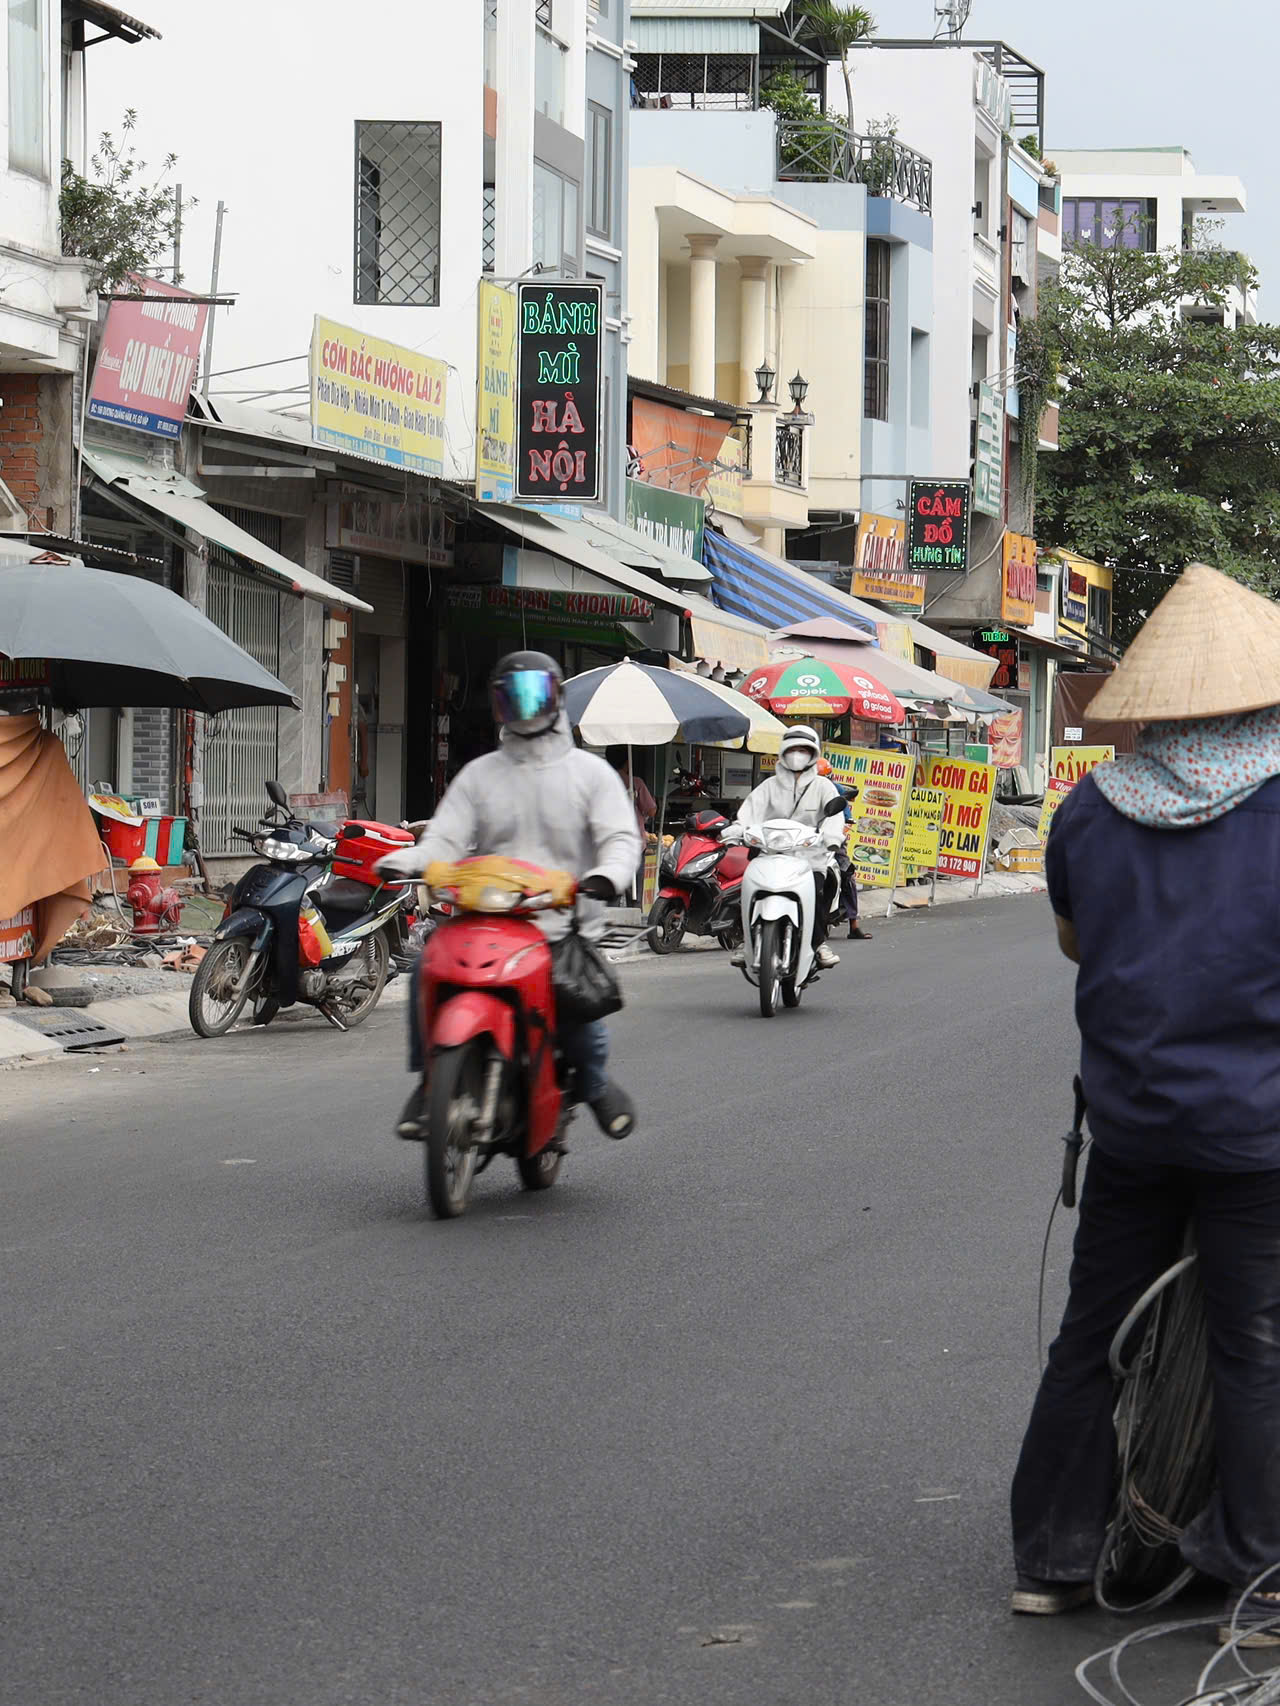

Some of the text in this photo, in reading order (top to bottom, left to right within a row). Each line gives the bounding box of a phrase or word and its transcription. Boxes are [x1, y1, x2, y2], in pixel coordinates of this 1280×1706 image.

[523, 293, 597, 335] BÁNH
[322, 338, 348, 374] CƠM
[350, 338, 373, 383] BẮC
[374, 358, 414, 397] HƯƠNG
[435, 379, 442, 405] 2
[537, 343, 580, 384] MÌ
[484, 363, 508, 397] BÁNH
[531, 392, 585, 433] HÀ
[529, 440, 587, 491] NỘI
[917, 489, 962, 517] CẦM
[923, 517, 954, 544] ĐỒ
[913, 544, 962, 564] HƯNG TÍN
[566, 595, 616, 617] KHOAI
[790, 687, 827, 697] gojek
[871, 703, 892, 714] gofood
[853, 756, 868, 773] MÌ
[869, 758, 885, 777] HÀ
[886, 760, 907, 781] NỘI
[931, 765, 966, 790] CƠM
[969, 768, 989, 795] GÀ
[864, 779, 903, 792] HAMBURGER
[865, 807, 877, 816] XÔI
[956, 802, 983, 829] MỠ
[956, 831, 980, 853] LAN
[949, 857, 961, 870] 172
